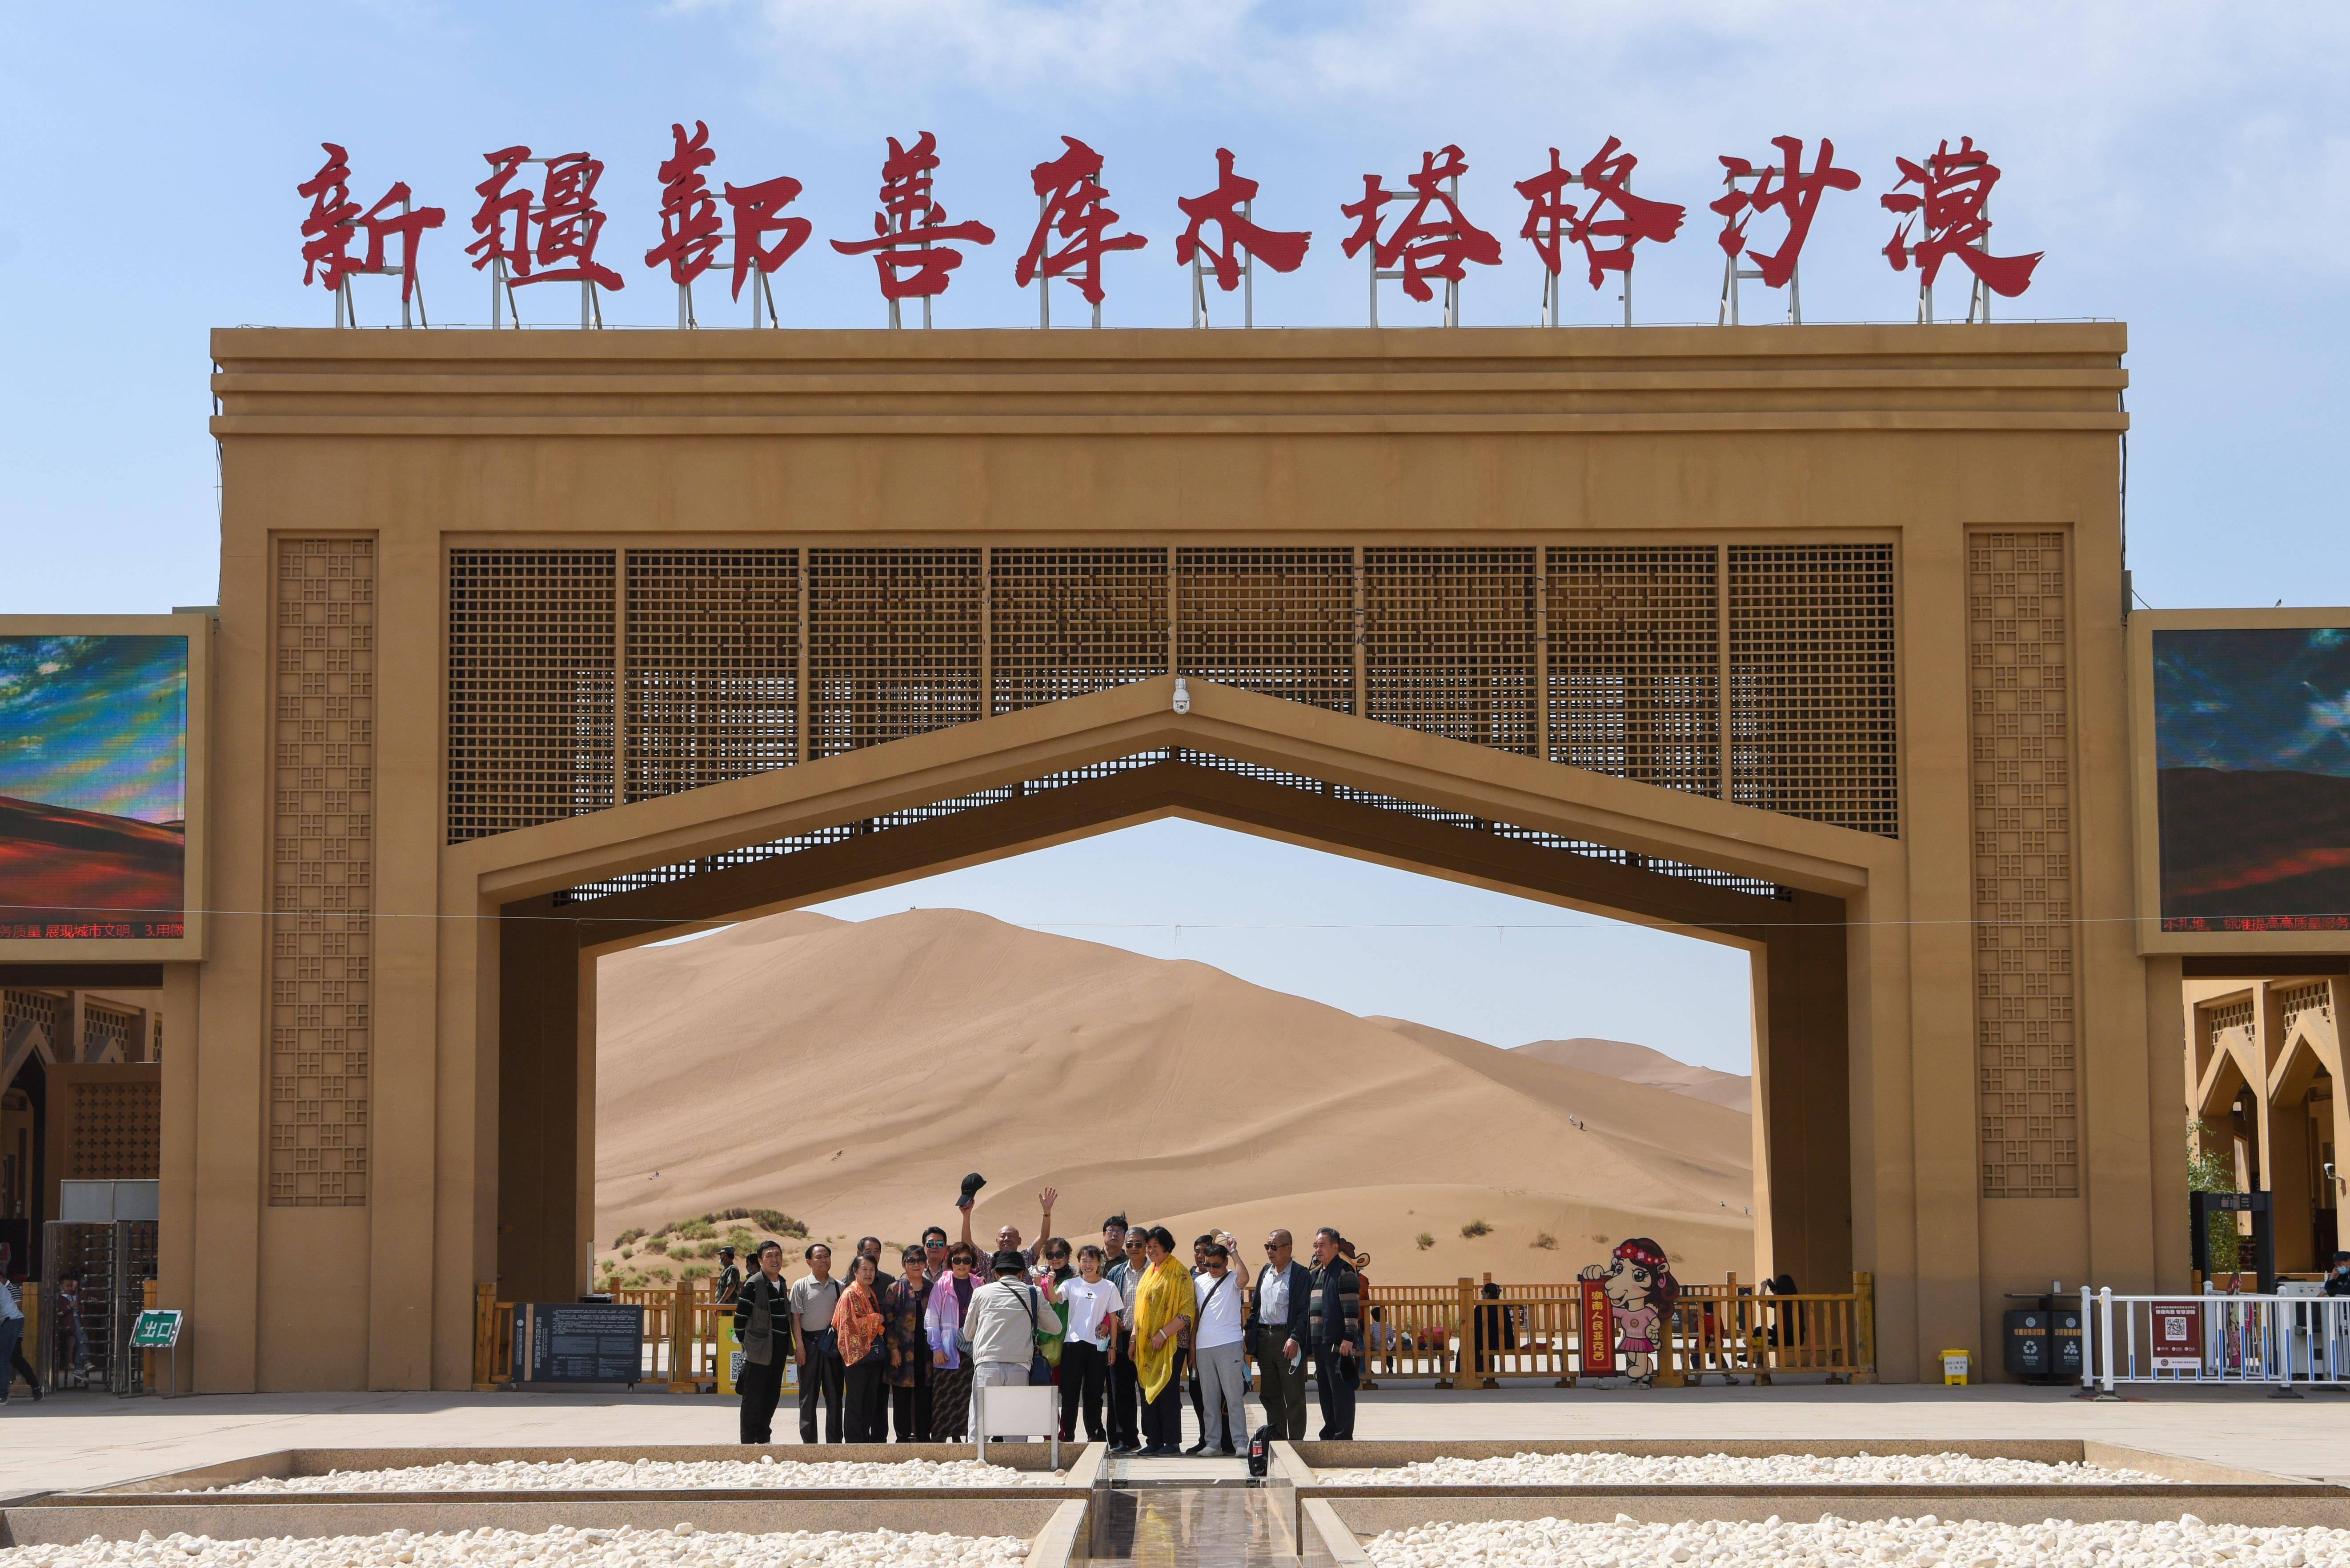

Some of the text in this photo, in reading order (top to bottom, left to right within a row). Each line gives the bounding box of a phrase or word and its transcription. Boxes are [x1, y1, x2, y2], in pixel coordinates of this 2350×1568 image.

[297, 120, 2044, 304] 新疆鄯善库木塔格沙漠
[46, 924, 136, 938] 展现城市文明。
[140, 1320, 173, 1338] 出口
[1592, 1291, 1604, 1361] 湖南人民亚克西
